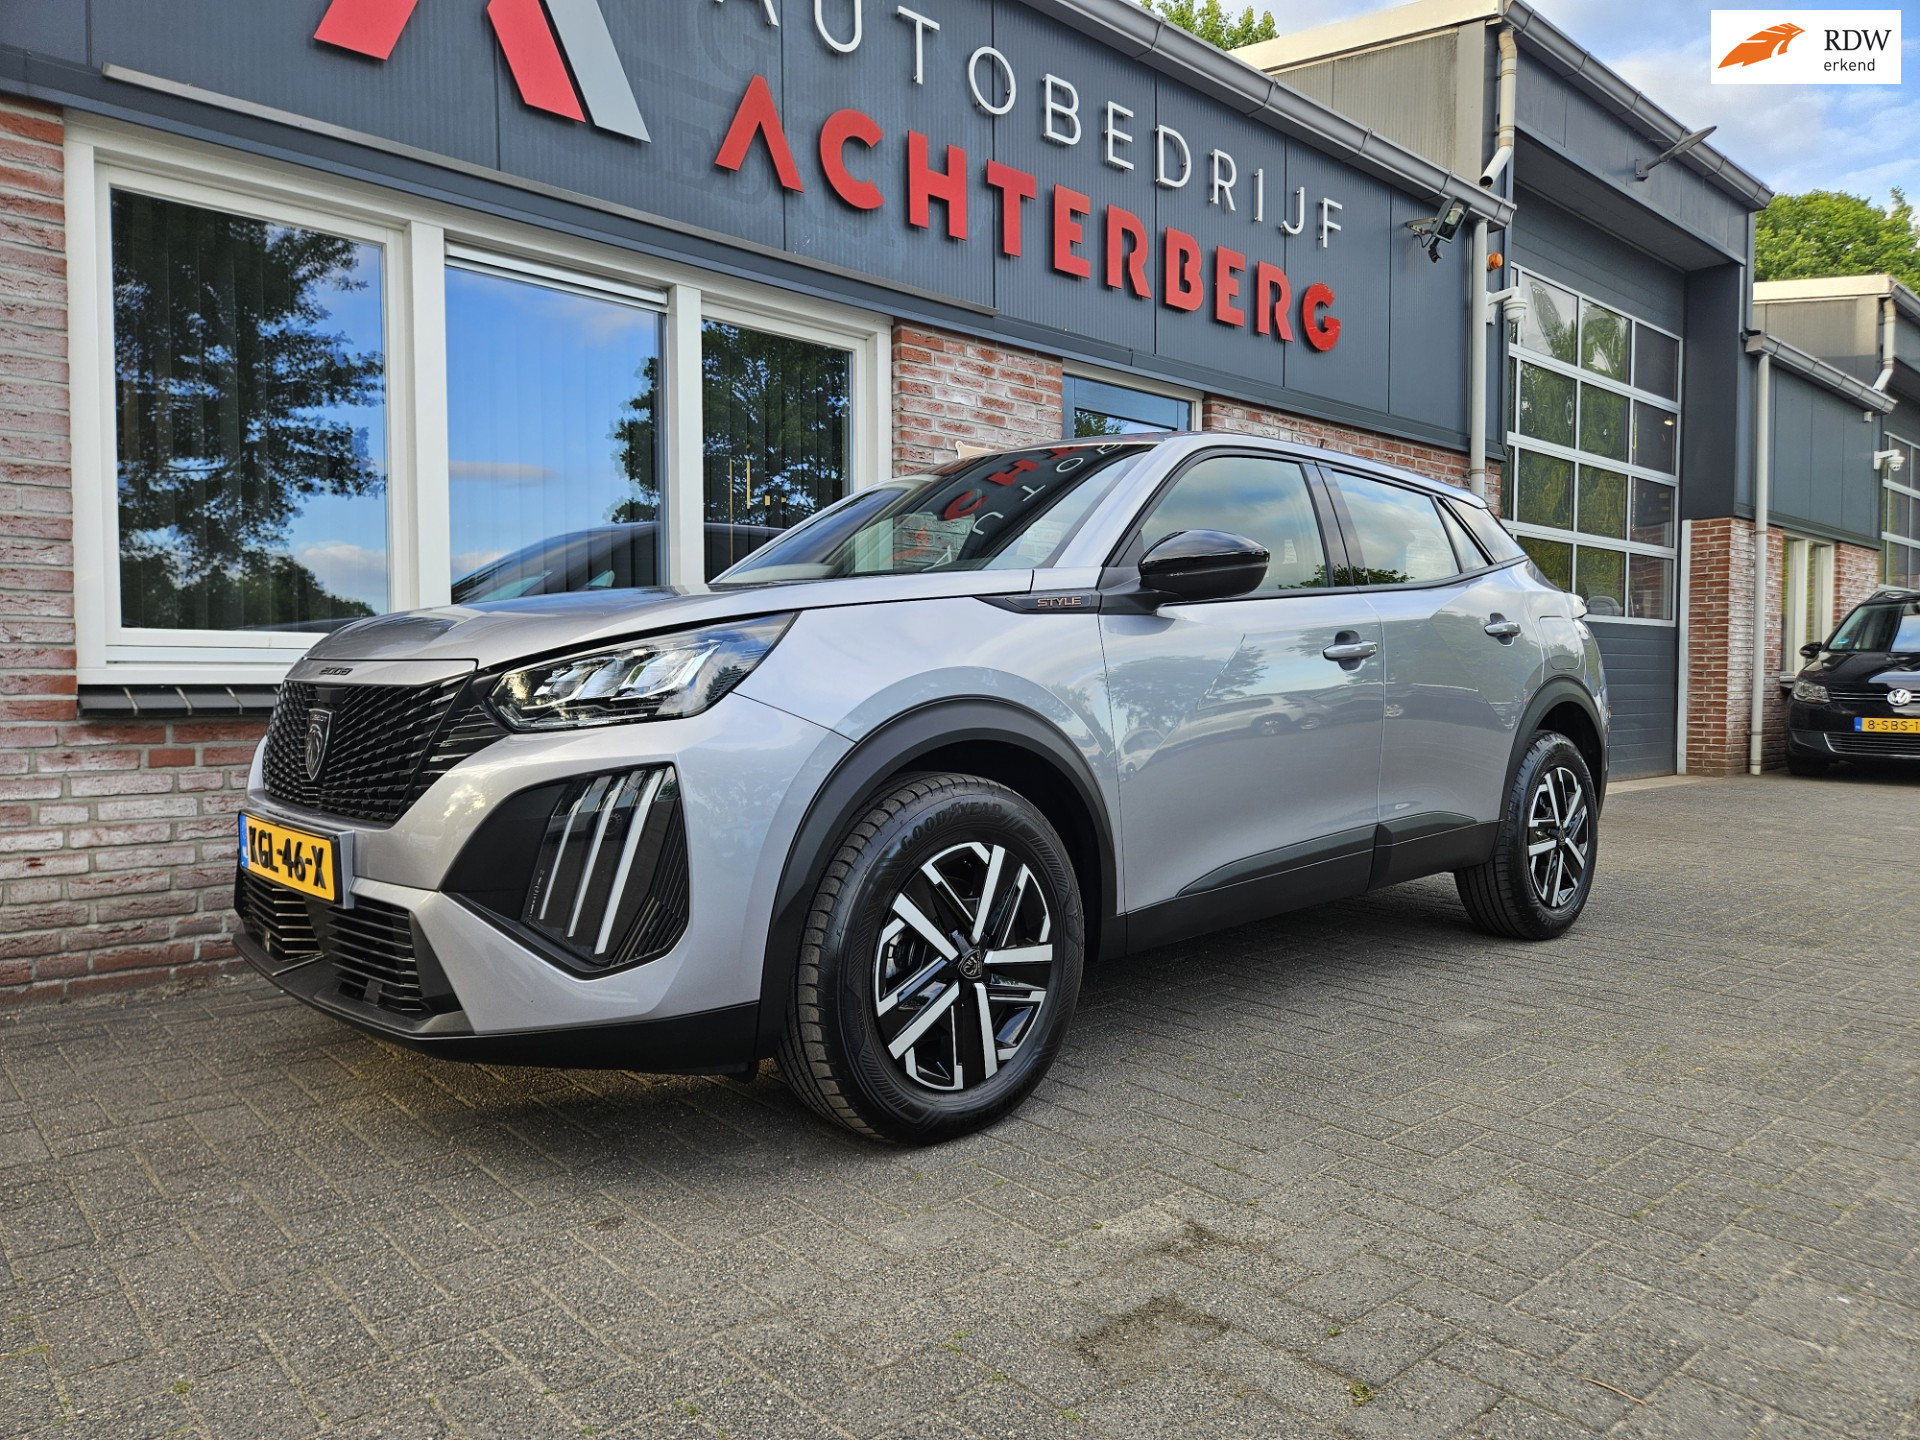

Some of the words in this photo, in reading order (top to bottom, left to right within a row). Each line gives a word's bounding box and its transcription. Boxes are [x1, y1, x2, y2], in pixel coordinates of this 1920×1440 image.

[713, 0, 1343, 249] UTOBEDRIJF
[714, 73, 1342, 353] ACHTERBERG
[1037, 596, 1081, 608] STYLE
